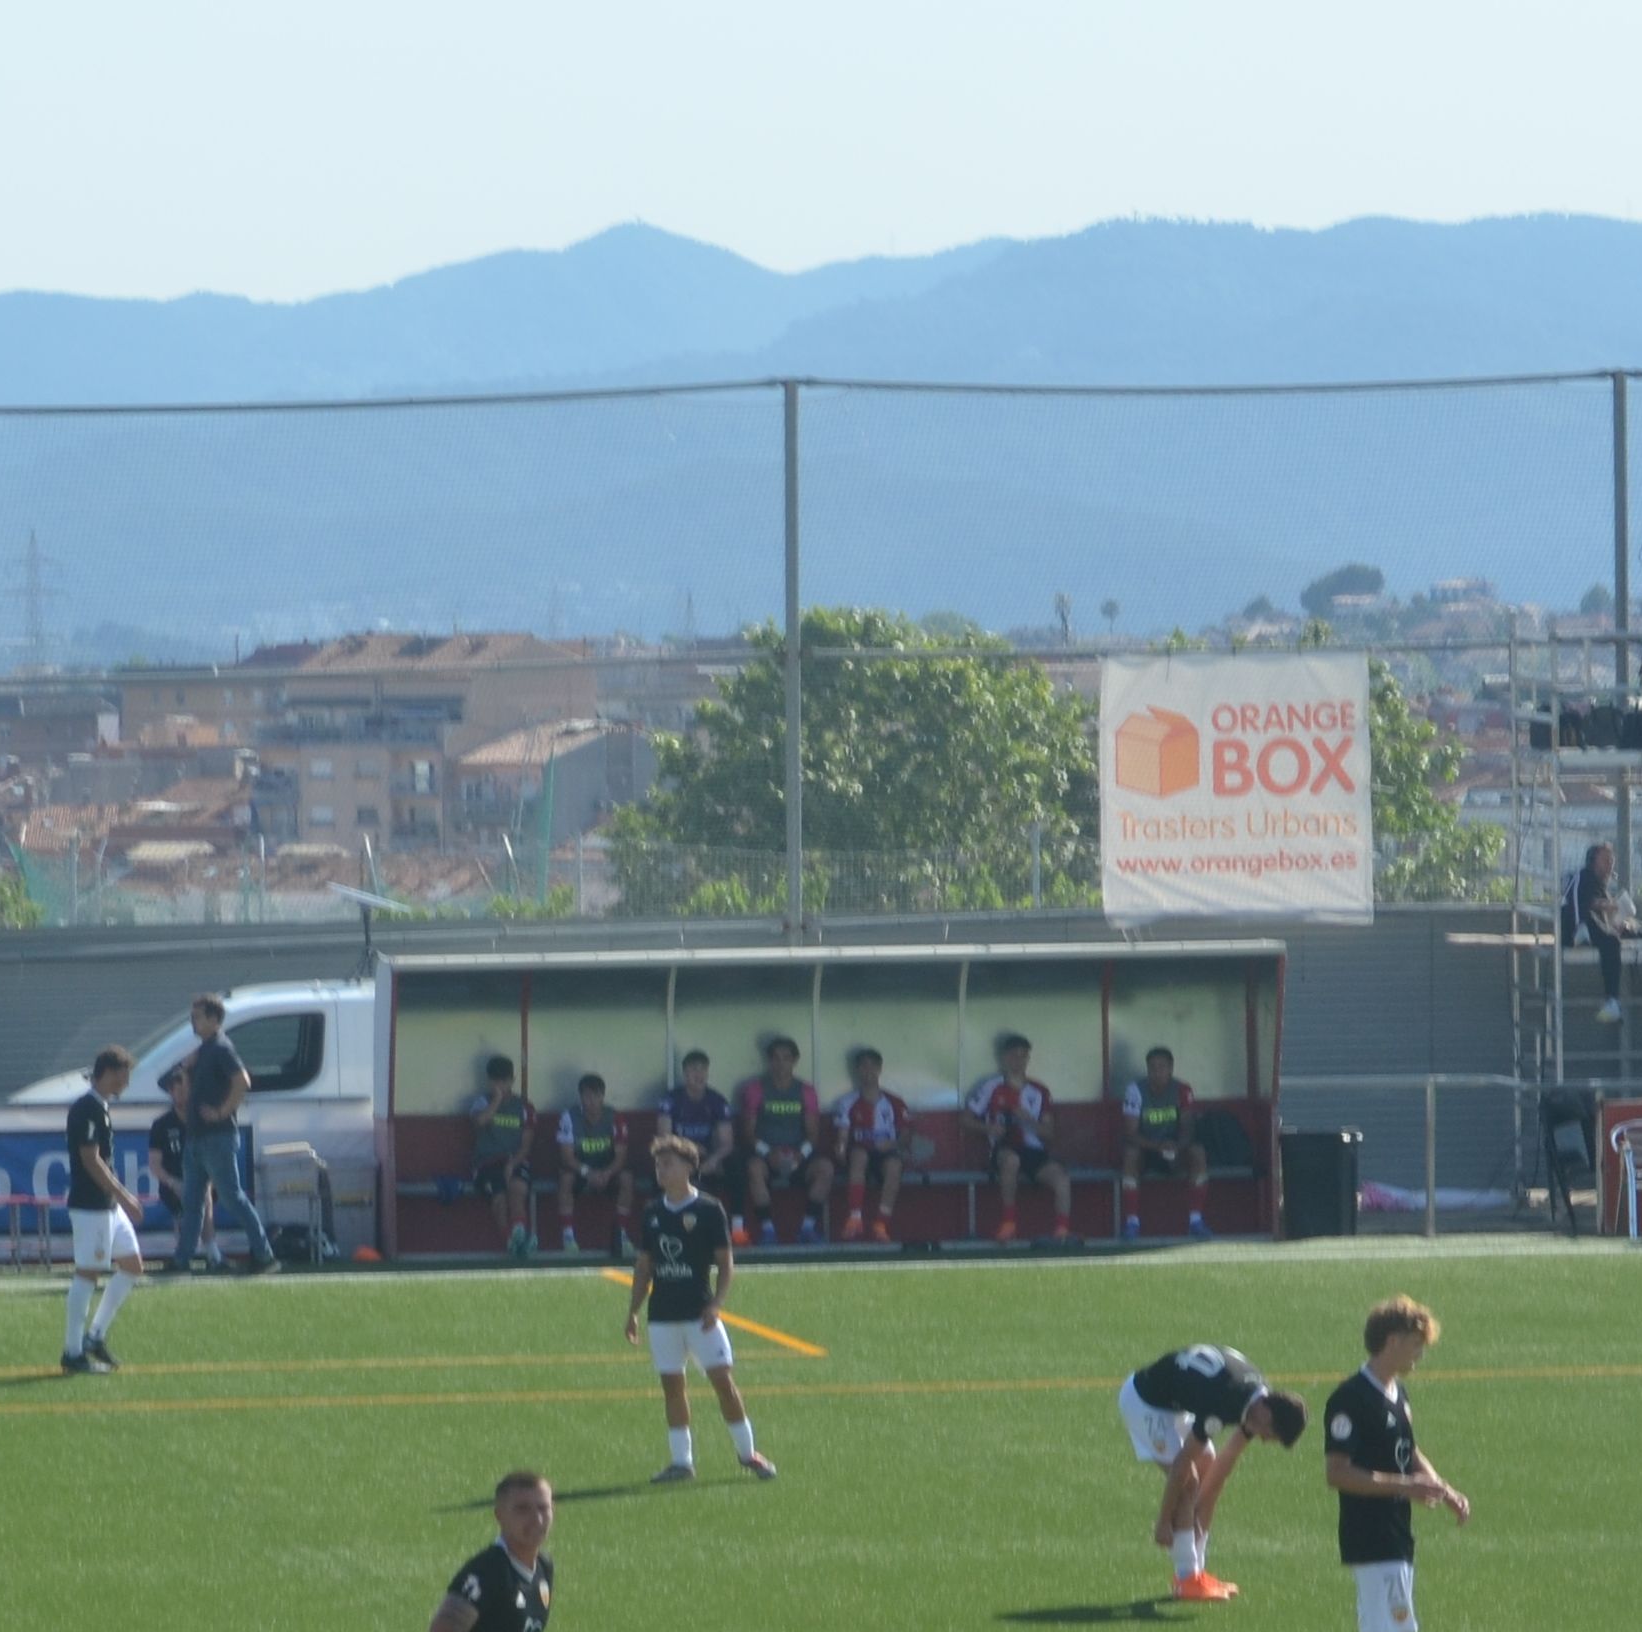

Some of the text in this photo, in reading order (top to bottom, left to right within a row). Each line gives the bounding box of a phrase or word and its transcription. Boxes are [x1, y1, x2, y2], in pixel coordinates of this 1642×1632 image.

[1212, 701, 1355, 734] ORANGE
[1212, 736, 1356, 798] BOX
[1116, 850, 1356, 876] www.orangebox.es
